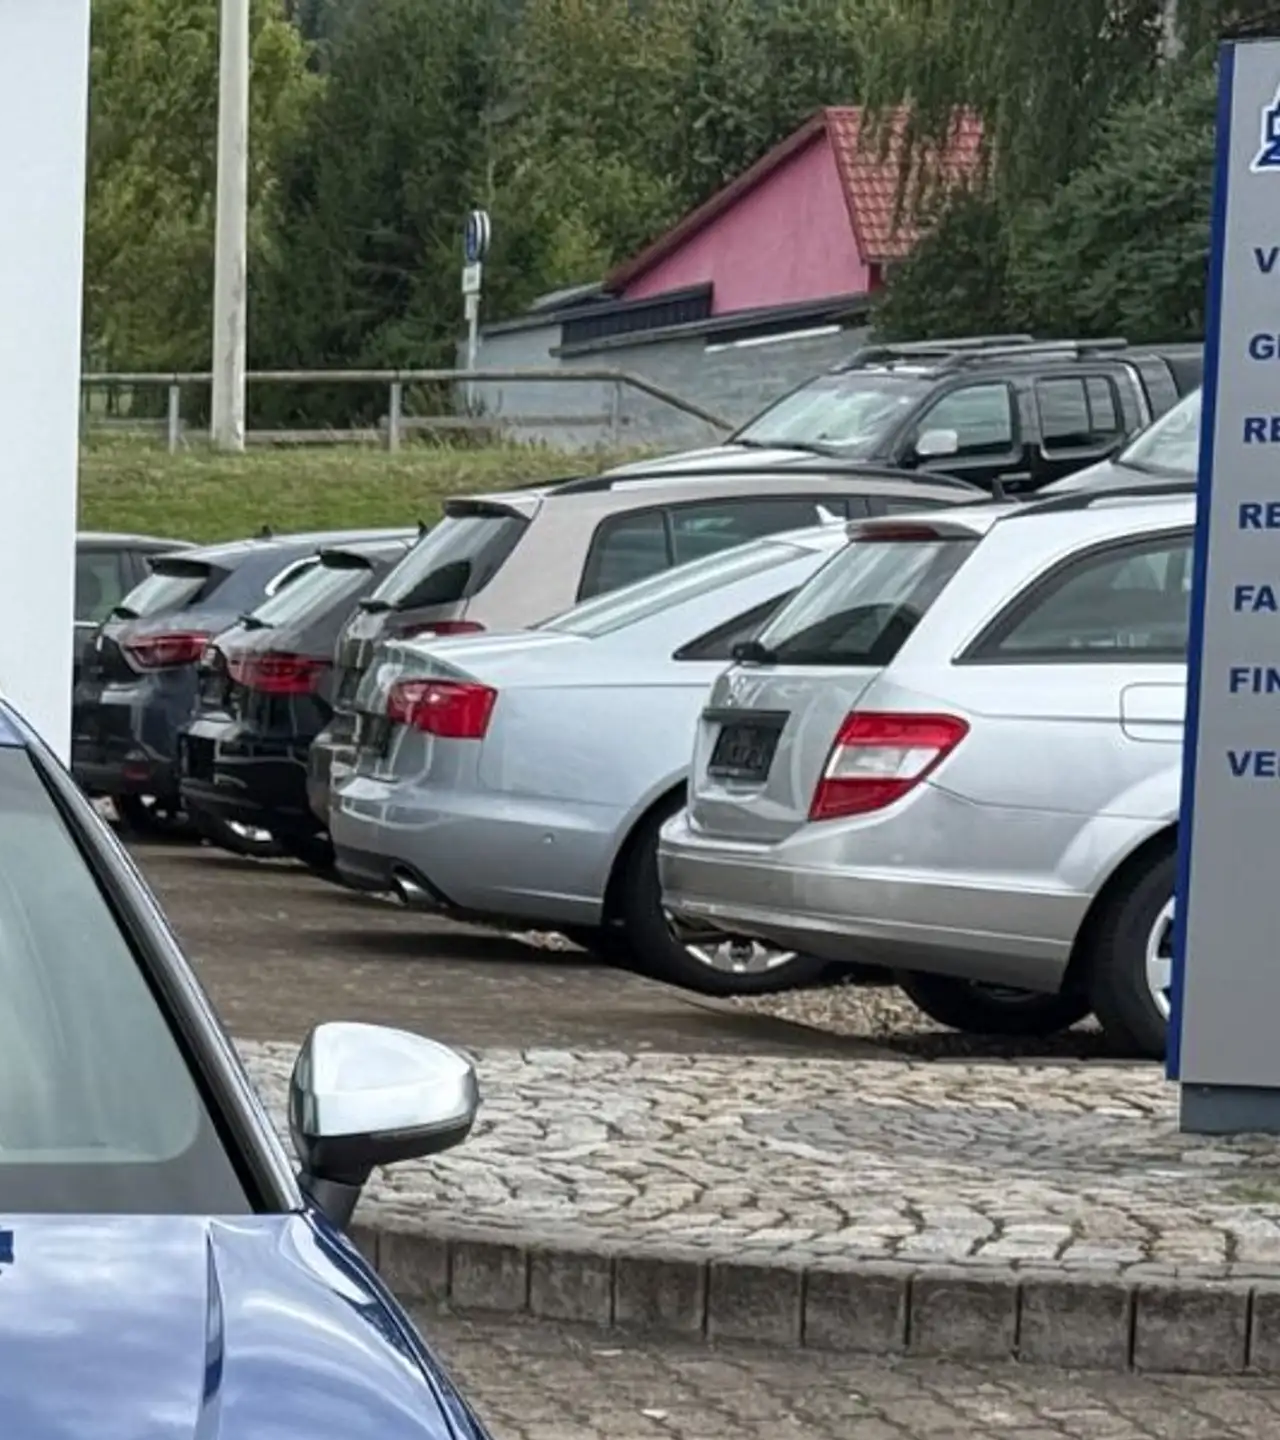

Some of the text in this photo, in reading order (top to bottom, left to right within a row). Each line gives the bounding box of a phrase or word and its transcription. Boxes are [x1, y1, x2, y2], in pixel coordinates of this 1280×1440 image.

[1249, 333, 1280, 361] G
[1239, 502, 1280, 530] RE
[1234, 585, 1279, 613] FA
[1226, 750, 1280, 778] VE
